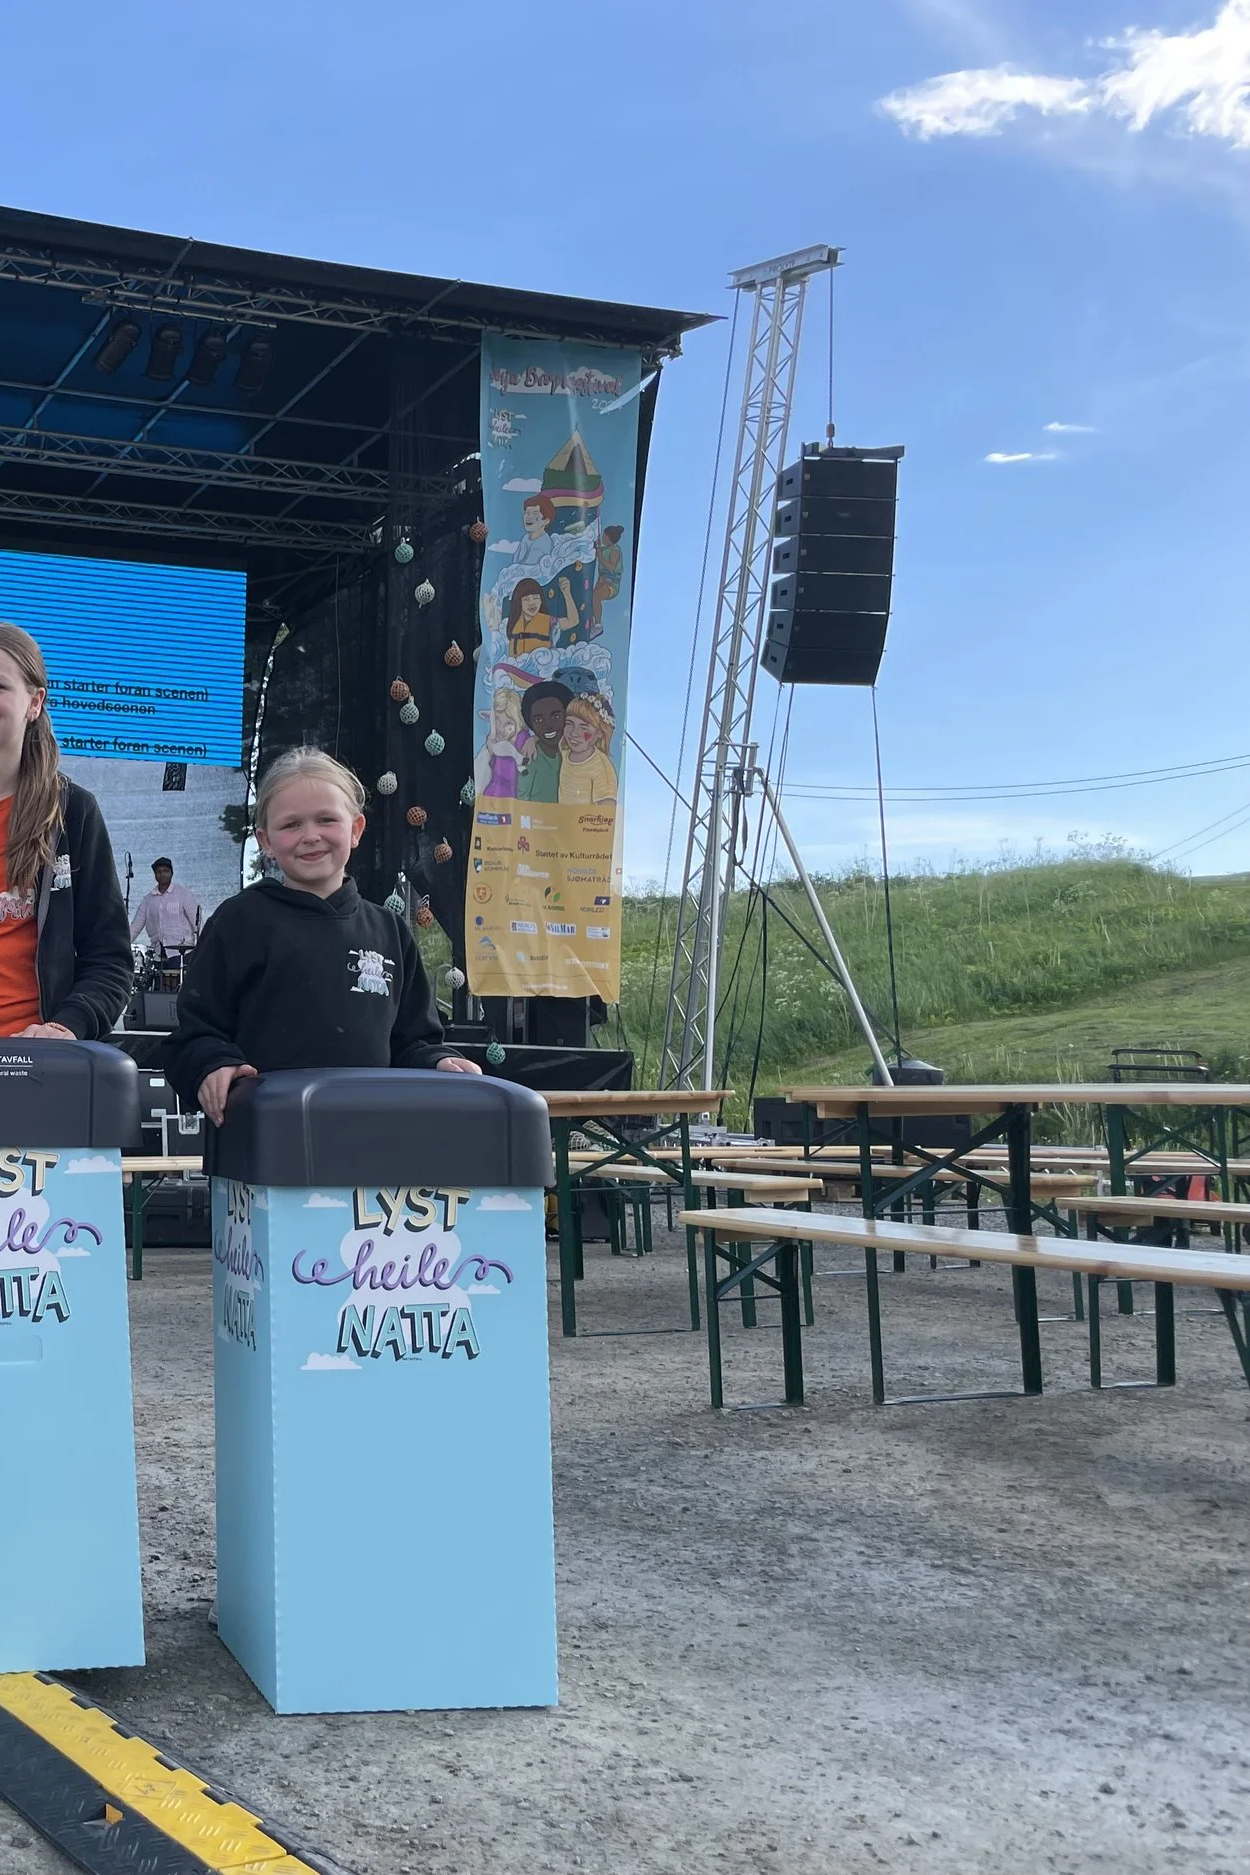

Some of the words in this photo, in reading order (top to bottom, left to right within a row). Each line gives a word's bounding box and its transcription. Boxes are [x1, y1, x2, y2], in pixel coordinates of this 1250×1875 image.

[63, 679, 111, 693] starter
[115, 682, 151, 697] foran
[155, 687, 209, 702] scenen)
[62, 697, 156, 715] hovedscenen
[61, 735, 110, 750] starter
[113, 737, 150, 752] foran
[153, 742, 207, 759] scenen)
[535, 849, 559, 858] Støttet
[569, 851, 613, 860] Kulturrådet
[10, 1069, 29, 1077] waste
[227, 1179, 255, 1226] LYST
[352, 1186, 472, 1237] LYST
[223, 1283, 257, 1352] NATTA
[336, 1302, 482, 1362] NATTA
